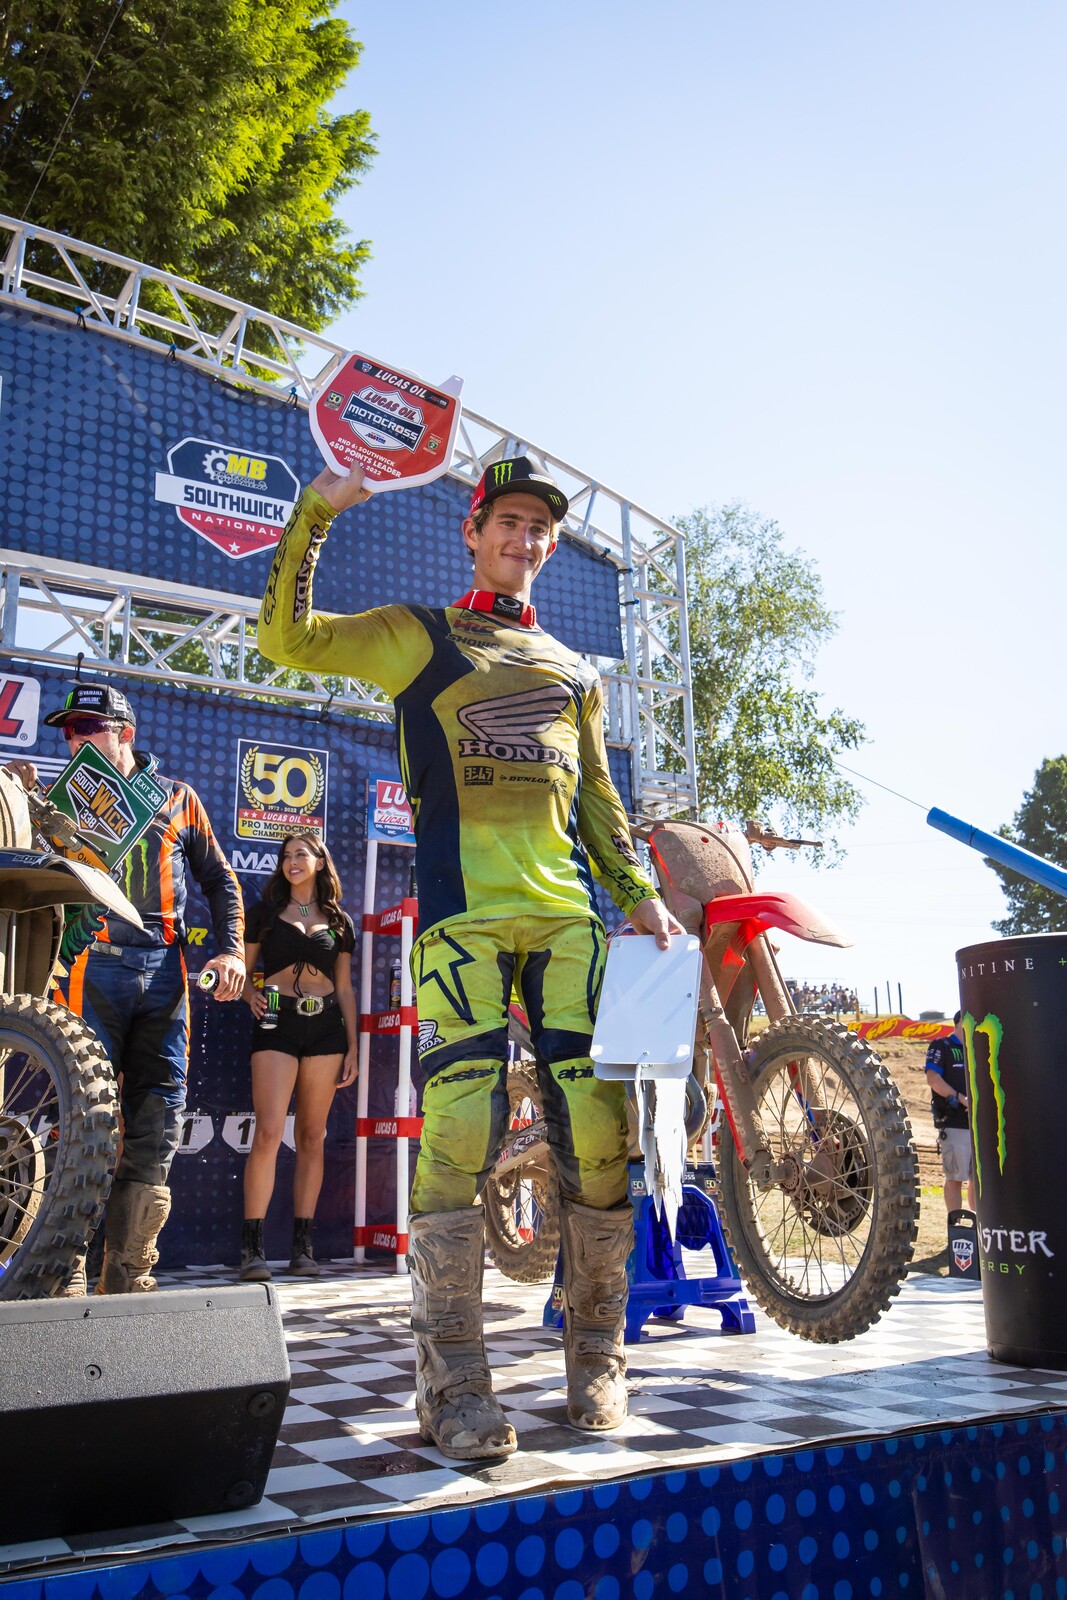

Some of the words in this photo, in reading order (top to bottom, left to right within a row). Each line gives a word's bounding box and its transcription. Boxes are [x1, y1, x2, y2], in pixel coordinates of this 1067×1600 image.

[375, 369, 411, 393] LUCAS
[409, 385, 427, 399] OIL
[329, 393, 342, 404] 50
[364, 392, 400, 411] LUCAS
[398, 407, 417, 421] OIL
[348, 404, 419, 441] MOTOCROSS
[329, 441, 345, 452] 450
[344, 448, 373, 464] POINTS
[372, 460, 402, 478] LEADER
[337, 437, 351, 446] RND
[358, 447, 396, 467] SOUTHWICK
[225, 453, 267, 481] MB
[365, 465, 382, 475] 2022
[183, 484, 285, 522] SOUTHWICK
[191, 512, 277, 537] NATIONAL
[458, 739, 576, 776] HONDA
[250, 752, 318, 808] 50
[508, 776, 550, 784] DUNLOP
[136, 778, 151, 793] EXIT
[147, 789, 162, 806] 338
[381, 786, 407, 806] LU
[74, 771, 97, 798] SOUTH
[90, 784, 129, 836] WICK
[80, 808, 97, 829] 338
[241, 820, 261, 829] PRO
[263, 822, 320, 835] MOTOCROSS
[262, 812, 288, 822] LUCAS
[289, 815, 302, 824] OIL
[378, 815, 408, 825] LUCAS
[35, 833, 55, 855] FIRST
[252, 829, 289, 838] CHAMPIO
[380, 911, 397, 927] LUCAS
[378, 1015, 394, 1029] LUCAS
[902, 1023, 942, 1038] FMF
[417, 1036, 445, 1055] NDA
[375, 1122, 391, 1135] LUCAS
[373, 1232, 391, 1247] LUCAS
[979, 1222, 1055, 1258] STER
